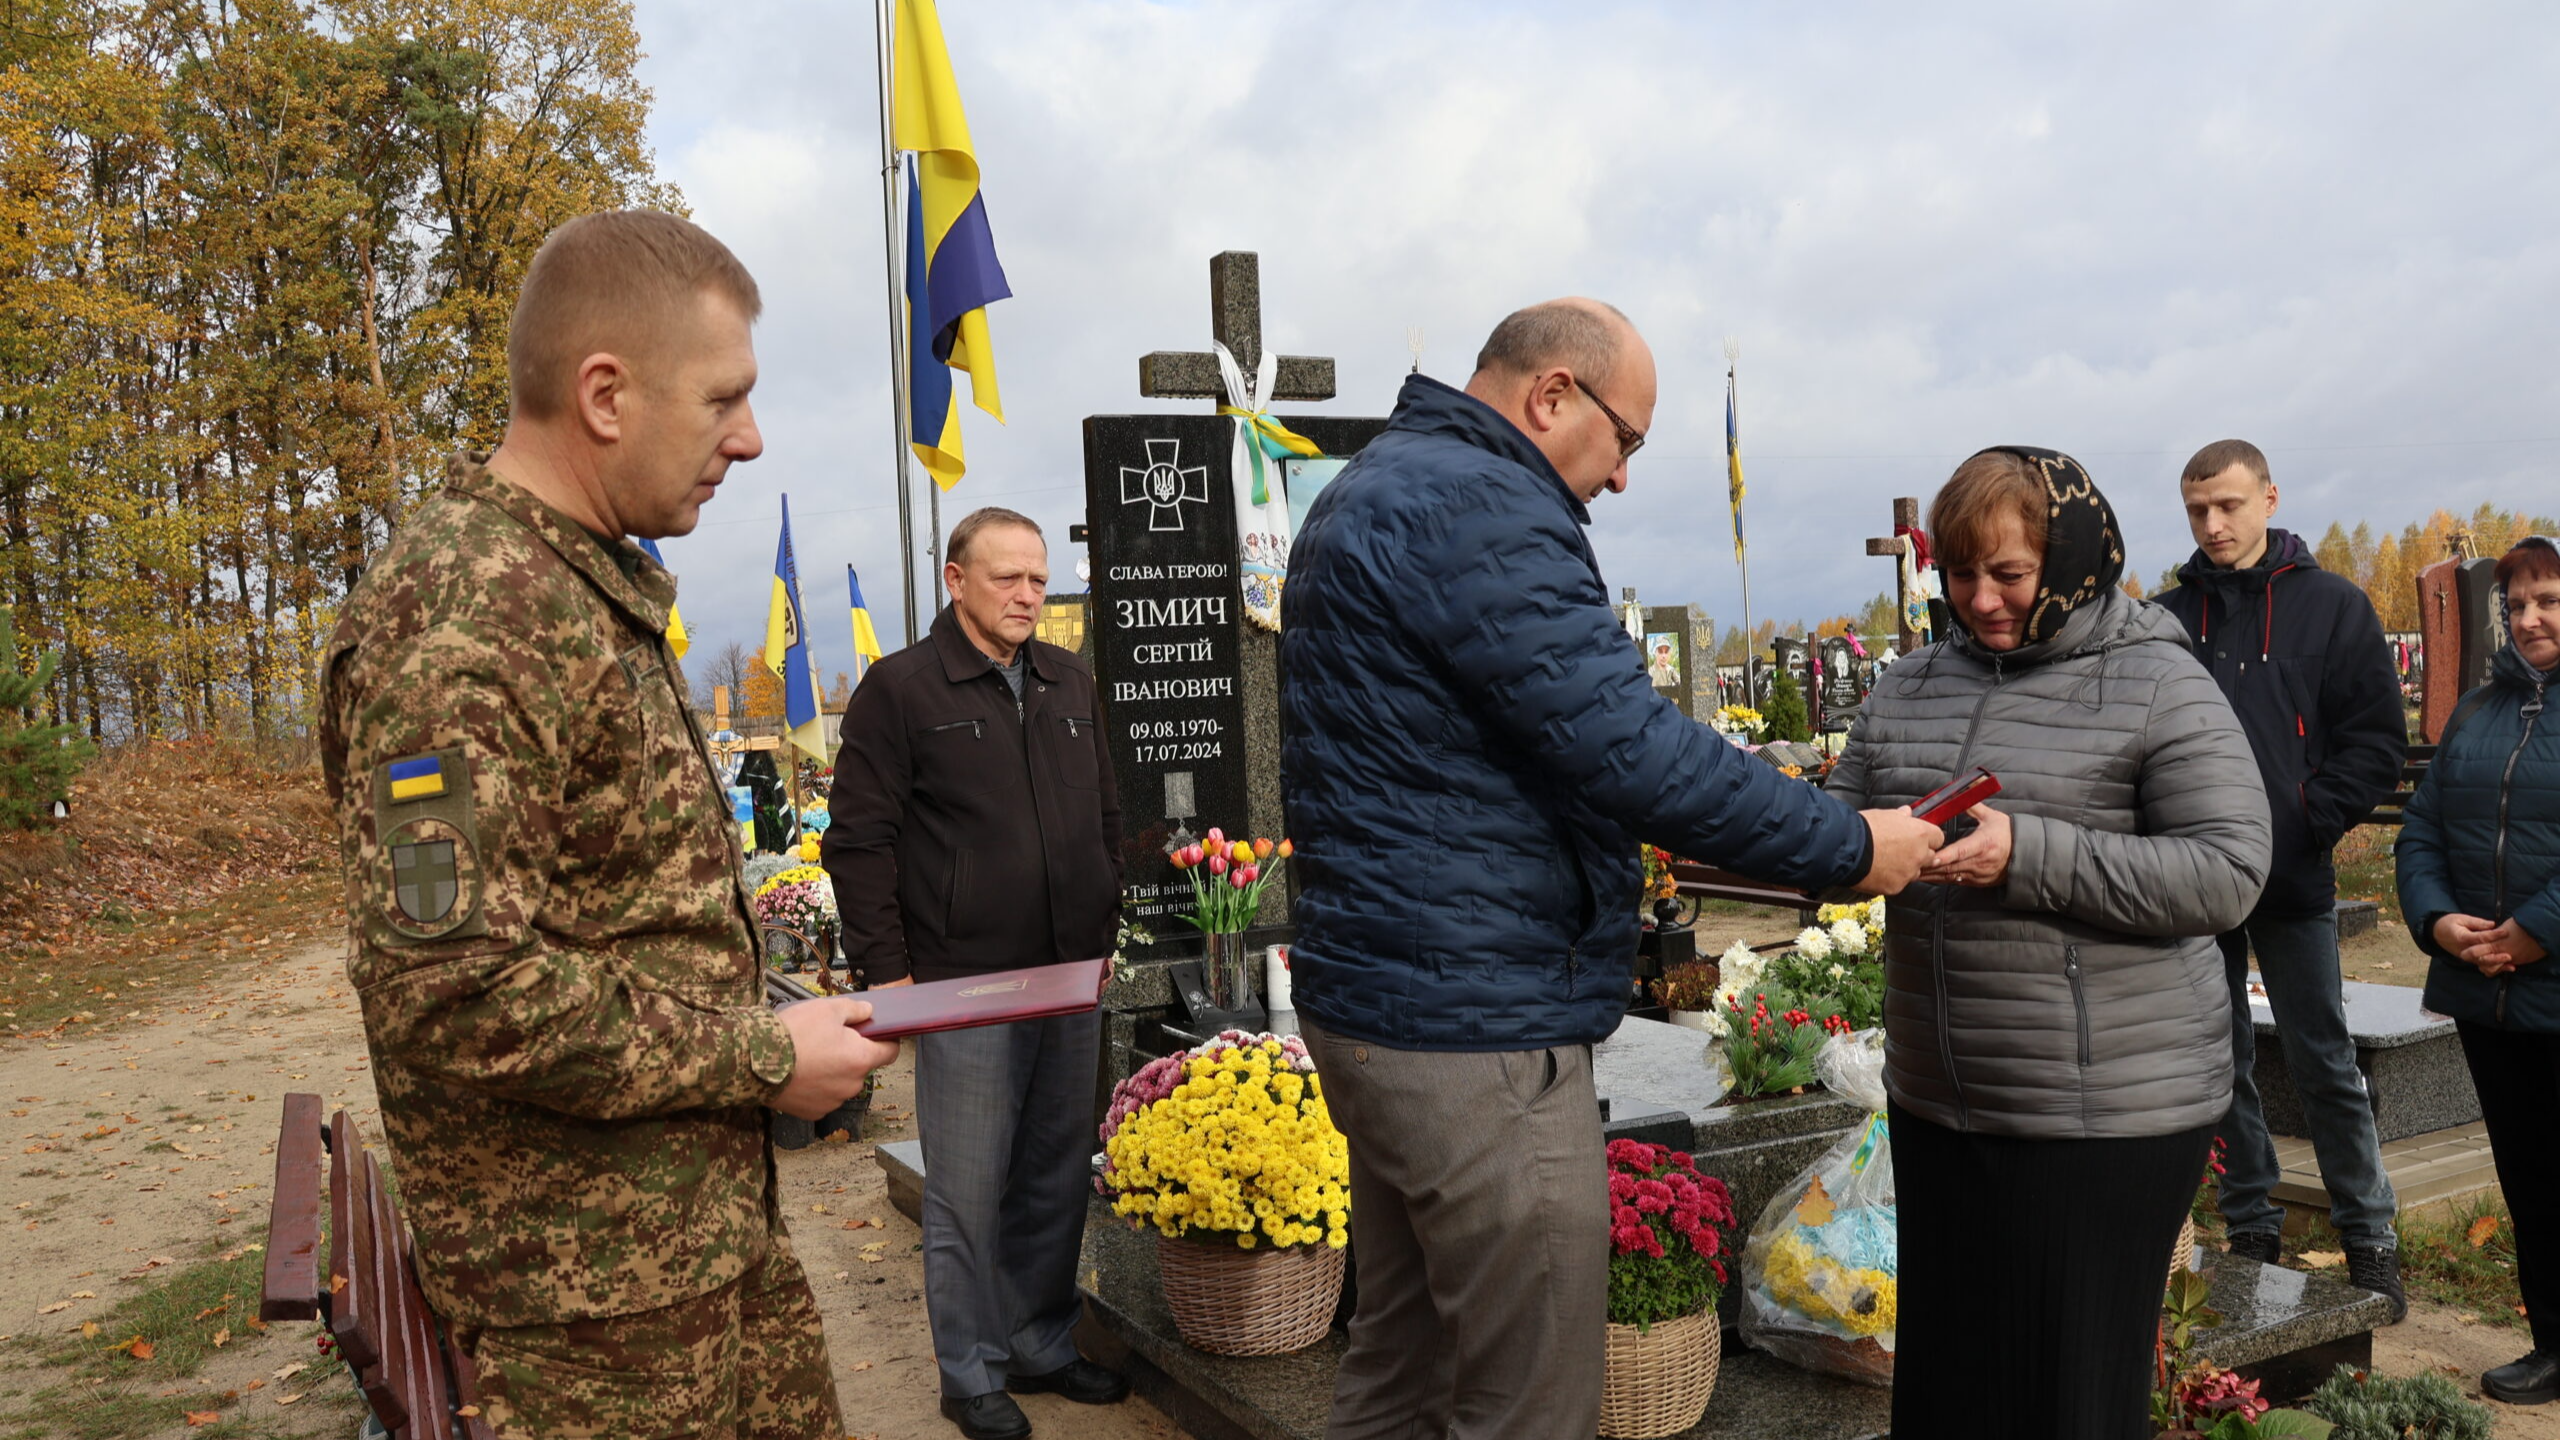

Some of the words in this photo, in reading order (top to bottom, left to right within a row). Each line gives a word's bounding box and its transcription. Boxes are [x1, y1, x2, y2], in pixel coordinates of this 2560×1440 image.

[1109, 565, 1165, 581] СЛАВА
[1167, 563, 1228, 580] ГЕРОЮ!
[1115, 596, 1229, 629] ЗІМИЧ
[1132, 637, 1214, 664] СЕРГІЙ
[1113, 677, 1233, 702] ІВАНОВИЧ
[1135, 741, 1222, 763] 17.07.2024
[1130, 884, 1159, 898] Твій
[1136, 904, 1163, 916] наш
